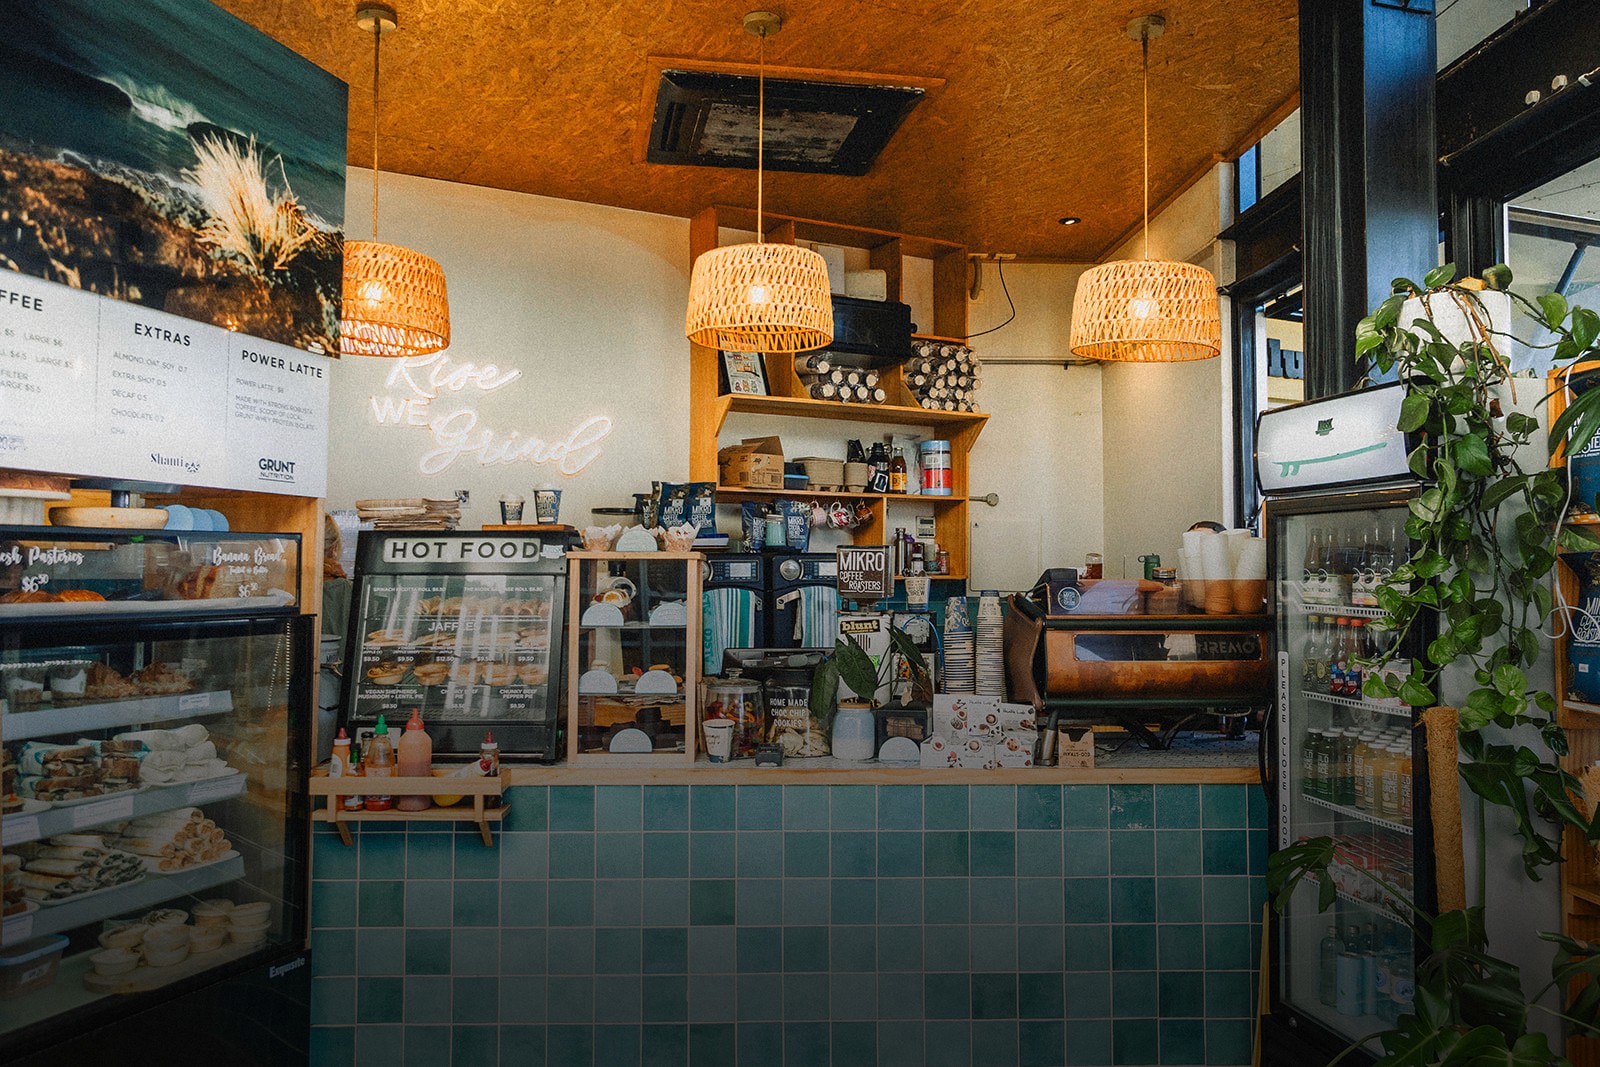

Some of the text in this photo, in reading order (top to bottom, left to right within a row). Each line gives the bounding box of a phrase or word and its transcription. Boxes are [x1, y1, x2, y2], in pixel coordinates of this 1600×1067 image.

[133, 322, 191, 347] EXTRAS
[242, 350, 323, 379] POWER LATTE
[112, 369, 136, 380] EXTRA
[137, 375, 156, 384] SHOT
[111, 388, 136, 399] DECAF
[370, 396, 430, 426] WE
[420, 408, 613, 476] Grind
[258, 457, 296, 474] GRUNT
[260, 472, 294, 480] NUTRITION
[212, 546, 283, 566] Banana Bread
[391, 541, 539, 559] HOT FOOD
[840, 551, 885, 572] MIKRO
[839, 571, 864, 583] COFFEE
[848, 580, 881, 593] ROASTERS
[428, 621, 482, 632] JAFFES
[841, 620, 879, 631] blunt
[769, 698, 808, 707] HOME MADE
[770, 708, 806, 717] CHOC CHIP
[773, 719, 803, 728] COOKIES
